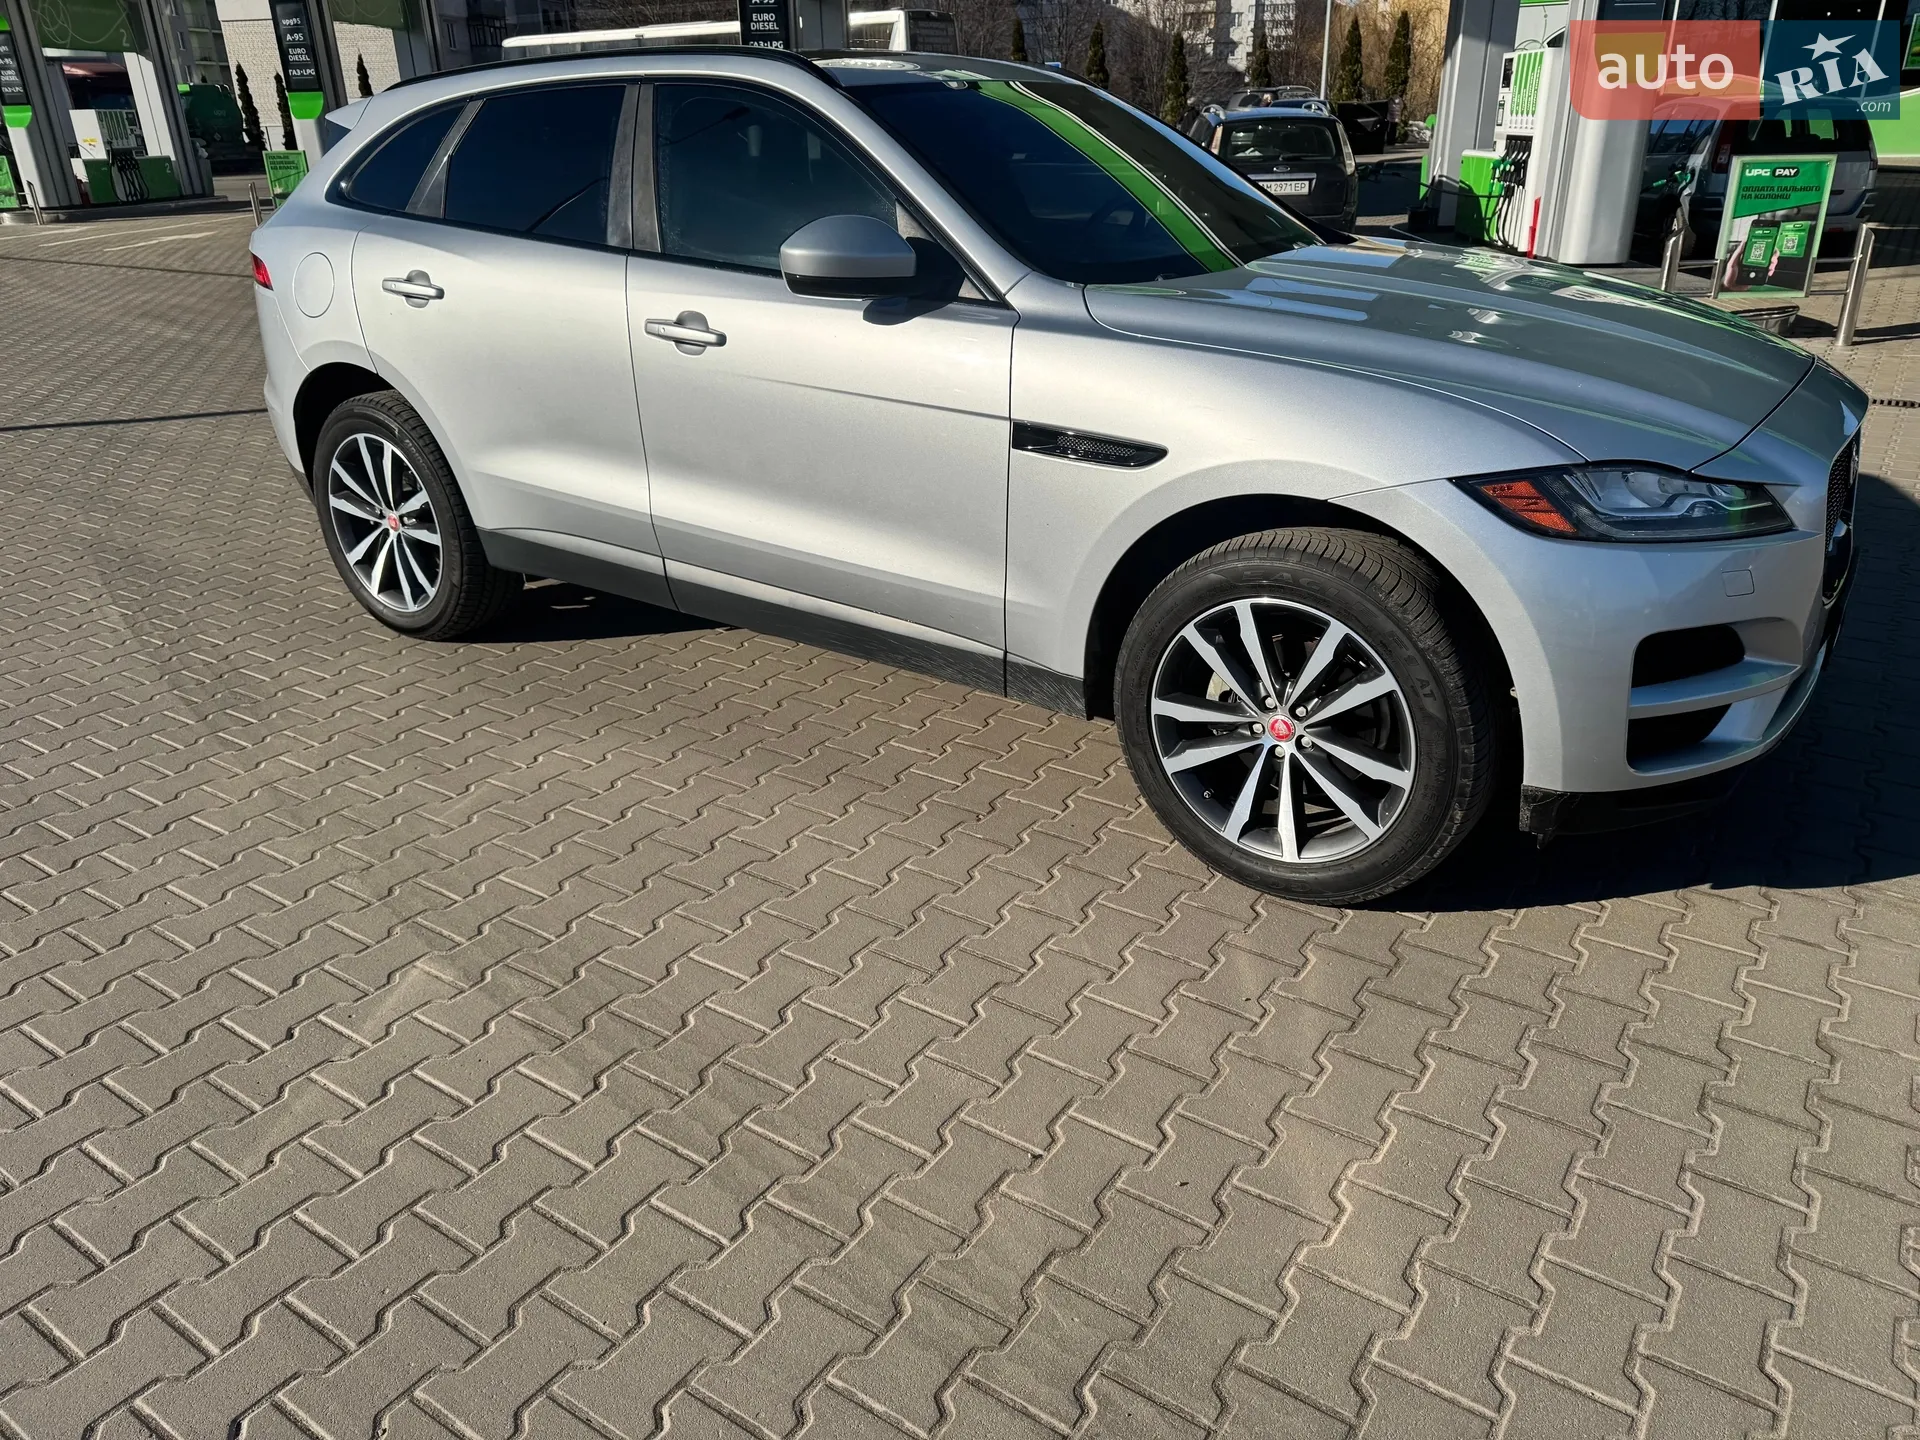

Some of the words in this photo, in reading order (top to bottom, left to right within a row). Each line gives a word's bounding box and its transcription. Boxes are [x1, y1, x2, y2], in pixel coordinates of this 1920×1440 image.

[282, 17, 301, 26] upg95
[752, 13, 776, 21] EURO
[750, 22, 780, 30] DIESEL
[119, 29, 130, 47] 2
[165, 163, 171, 174] 2
[1745, 168, 1771, 177] UPG
[1774, 168, 1798, 177] PAY
[1273, 182, 1293, 192] 2971
[1294, 182, 1306, 192] EP
[1241, 569, 1379, 620] EAGLE
[1415, 677, 1438, 703] AT
